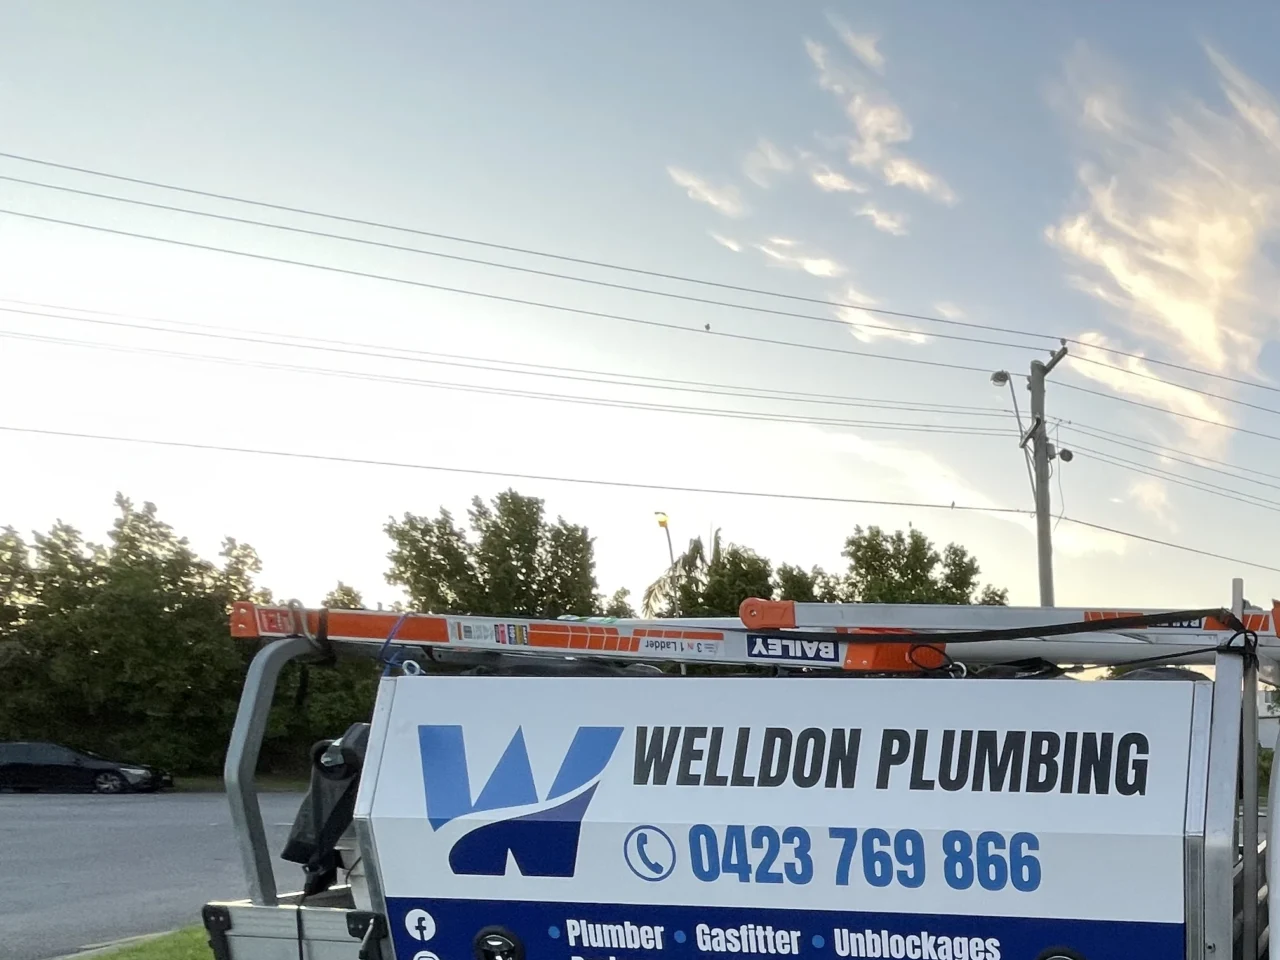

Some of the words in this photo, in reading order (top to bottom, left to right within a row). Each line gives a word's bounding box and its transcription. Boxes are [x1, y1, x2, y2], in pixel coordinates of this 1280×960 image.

[645, 639, 677, 651] Ladder
[697, 642, 703, 653] 3
[752, 637, 835, 659] BAILEY
[633, 725, 862, 788] WELLDON
[875, 729, 1150, 796] PLUMBING
[689, 824, 814, 885] 0423
[829, 827, 926, 888] 769
[942, 830, 1042, 893] 866
[566, 918, 664, 950] Plumber
[695, 923, 800, 955] Gasfitter
